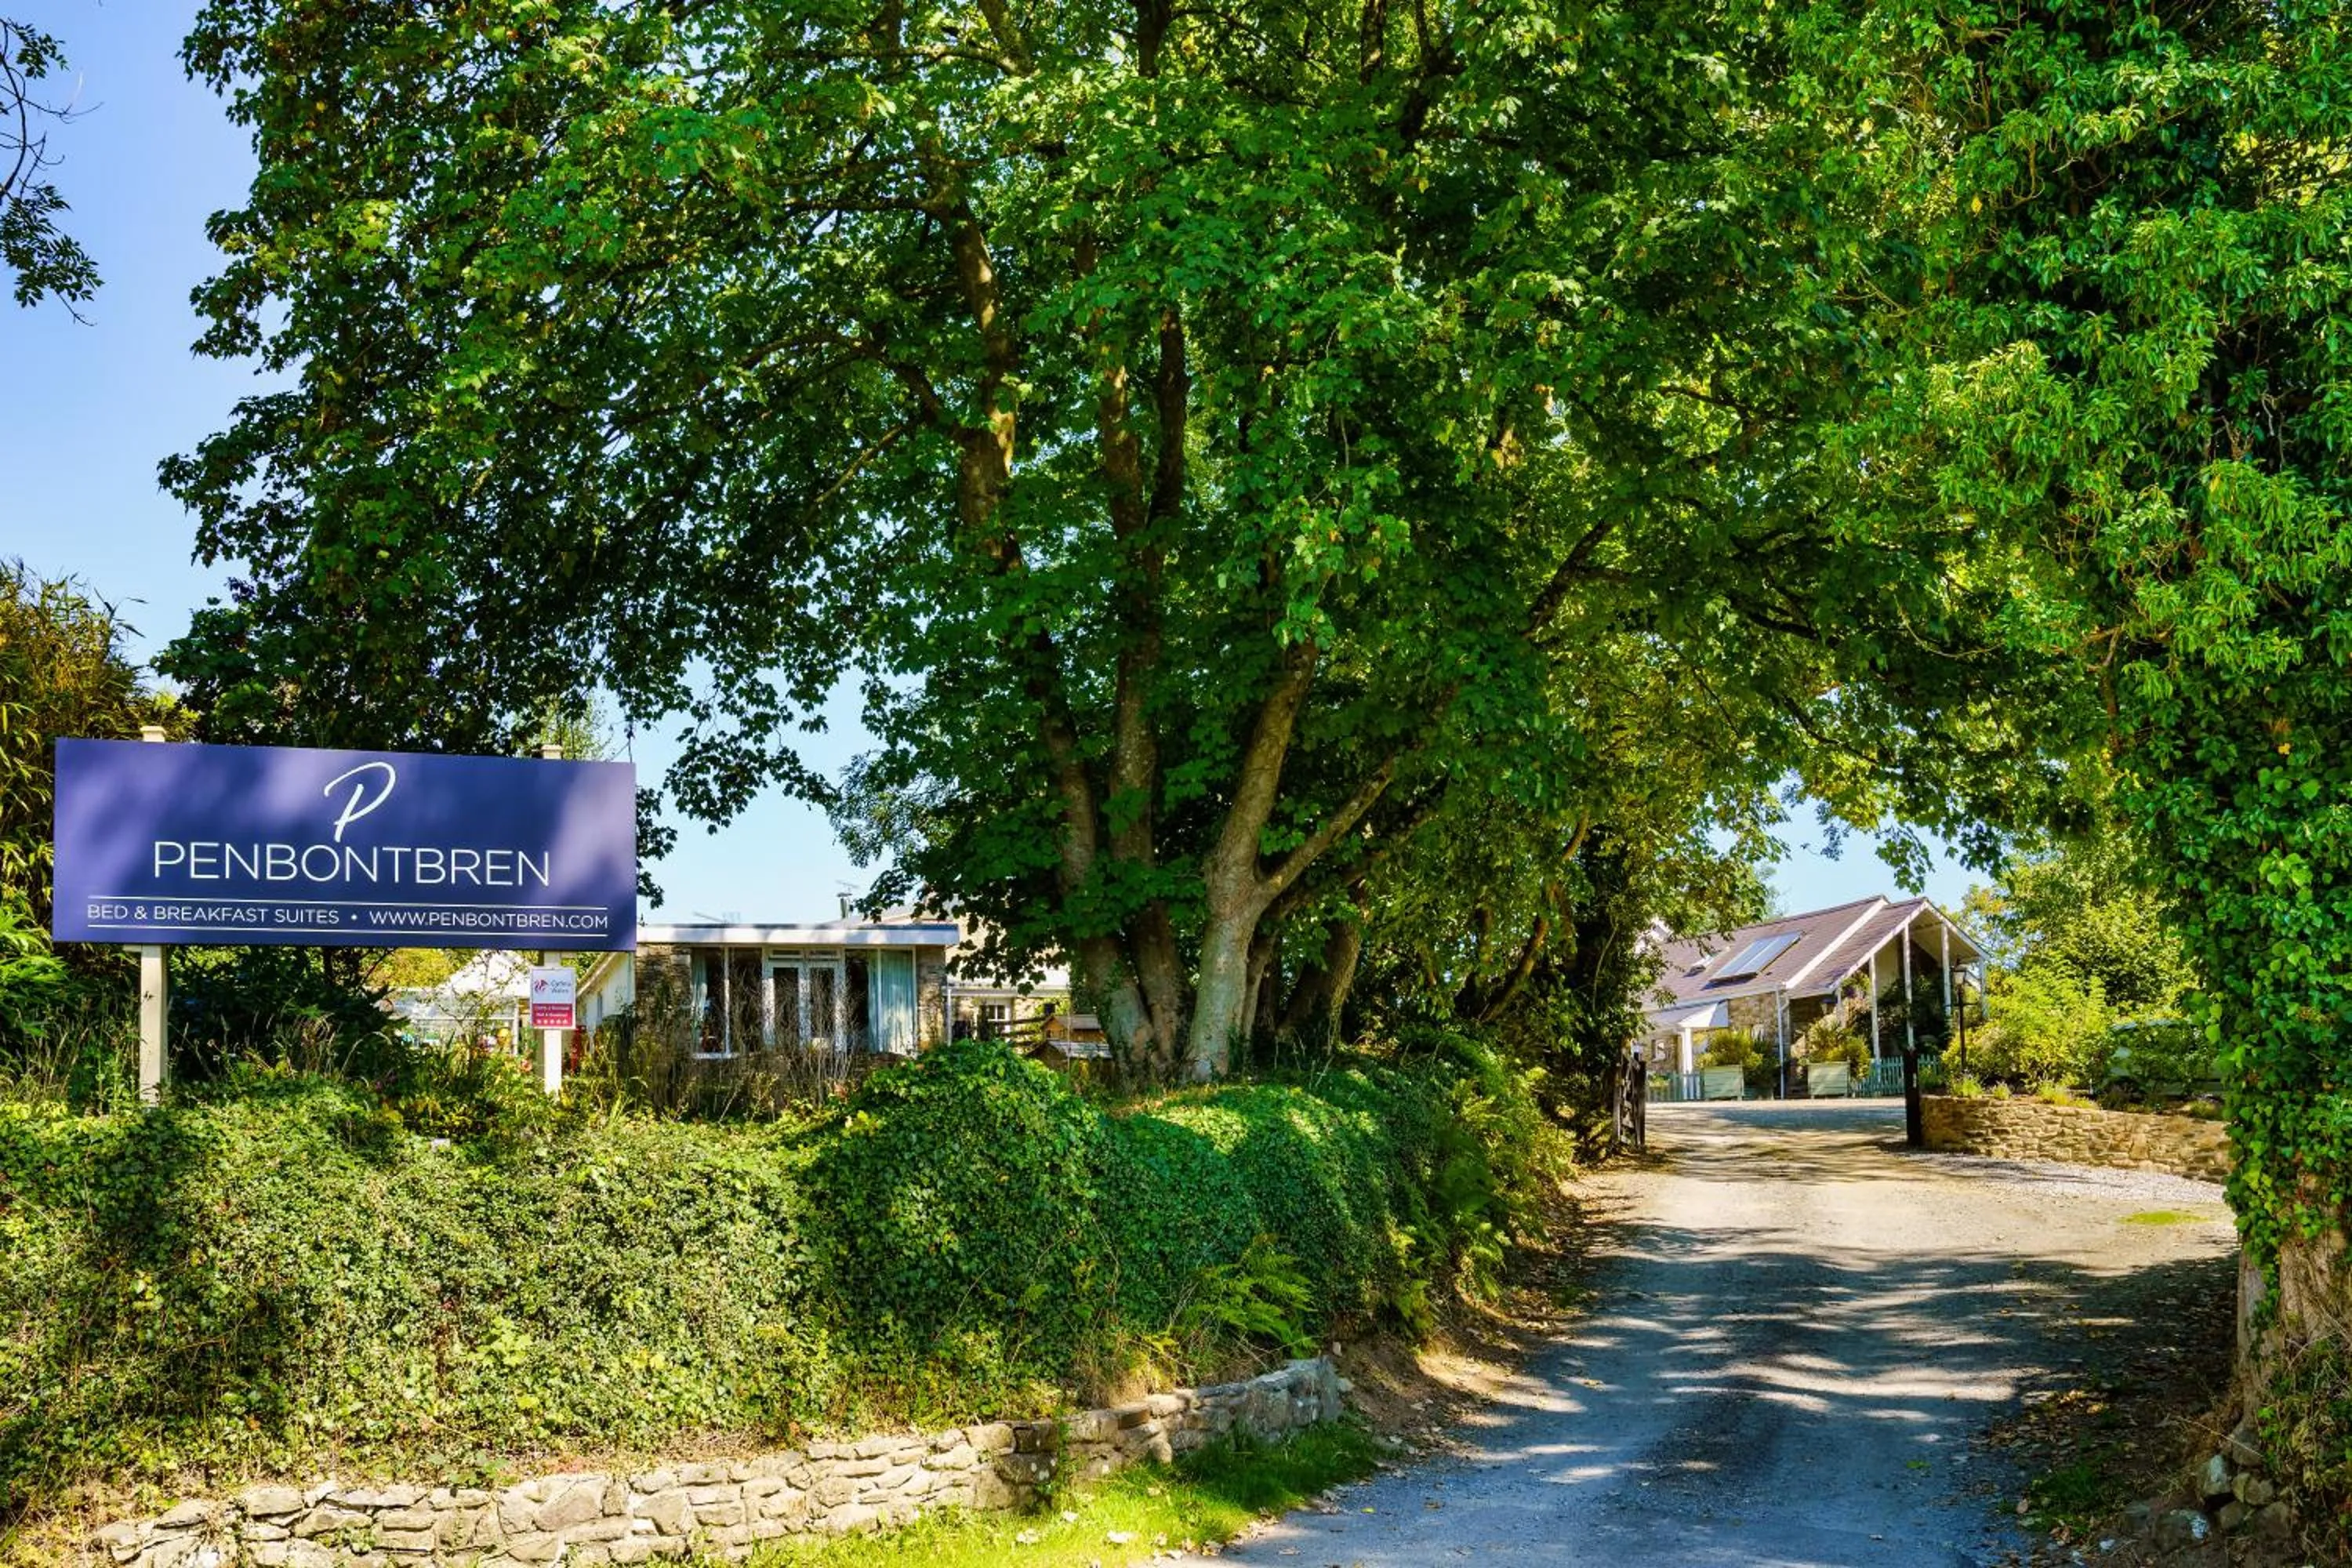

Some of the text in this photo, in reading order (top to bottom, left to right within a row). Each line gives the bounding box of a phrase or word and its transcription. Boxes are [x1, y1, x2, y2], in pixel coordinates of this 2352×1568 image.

[324, 761, 397, 843] P
[154, 840, 550, 887] PENBONTBREN
[87, 904, 608, 929] BED & BREAKFAST SUITES WWW.PENBONTBREN.COM
